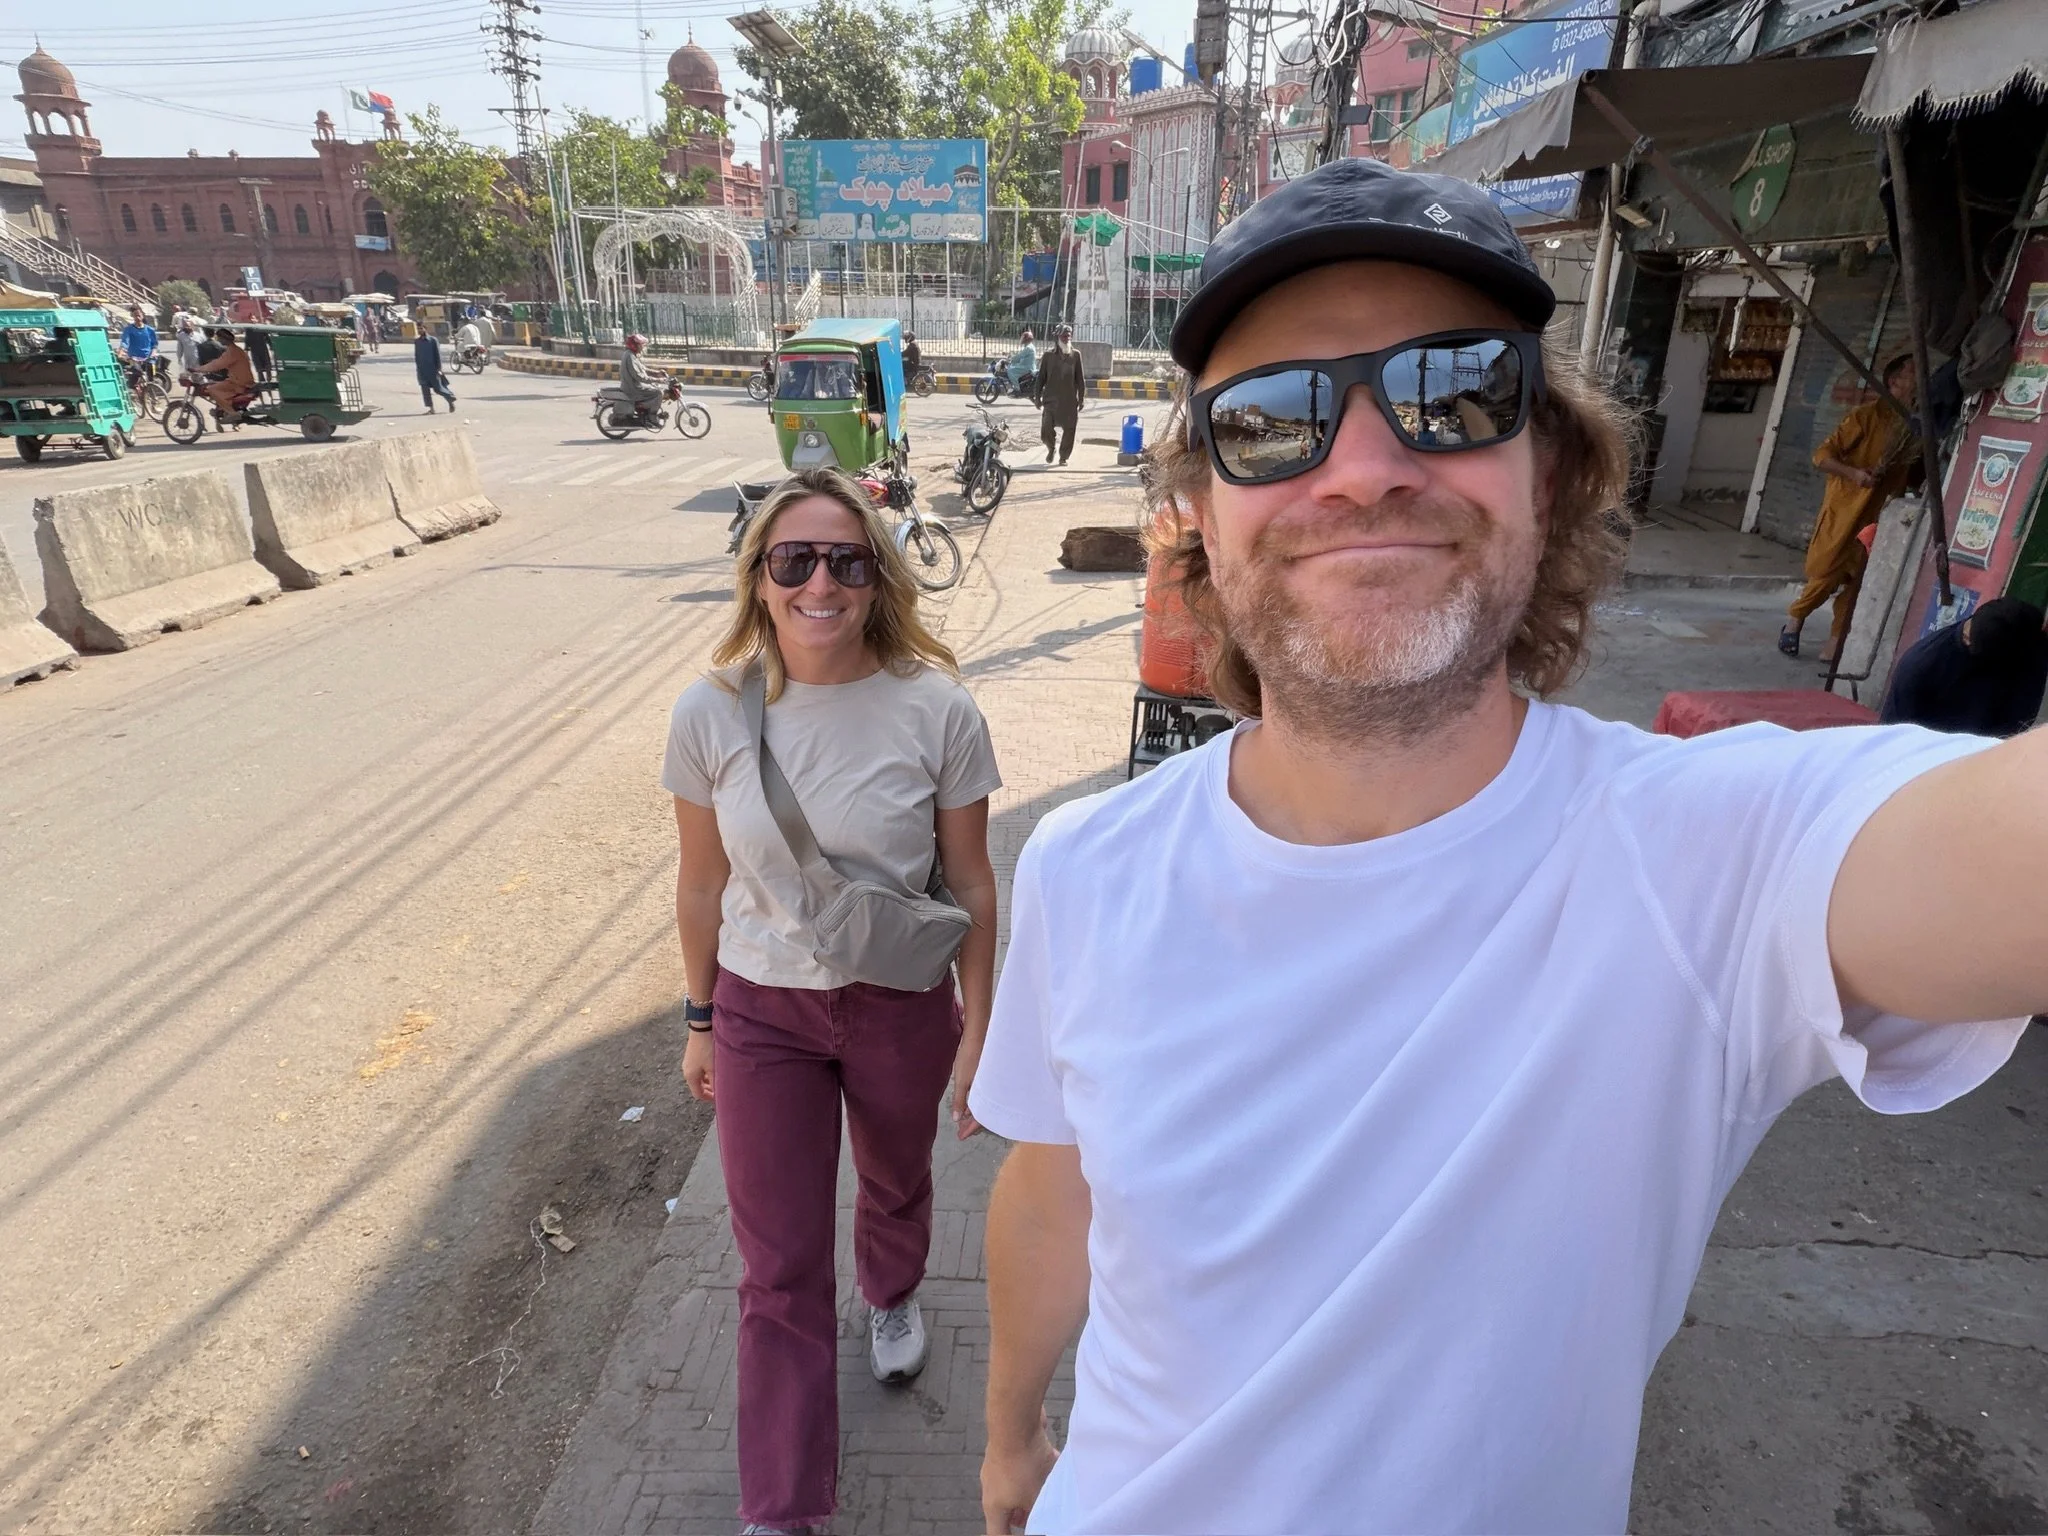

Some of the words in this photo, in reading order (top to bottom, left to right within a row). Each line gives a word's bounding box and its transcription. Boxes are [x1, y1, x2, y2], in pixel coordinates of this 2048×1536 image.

[1764, 142, 1792, 166] SHOP
[839, 176, 894, 212] چوک
[897, 176, 953, 209] میلاد
[1749, 177, 1766, 218] 8
[1972, 487, 2004, 501] SAFEENA
